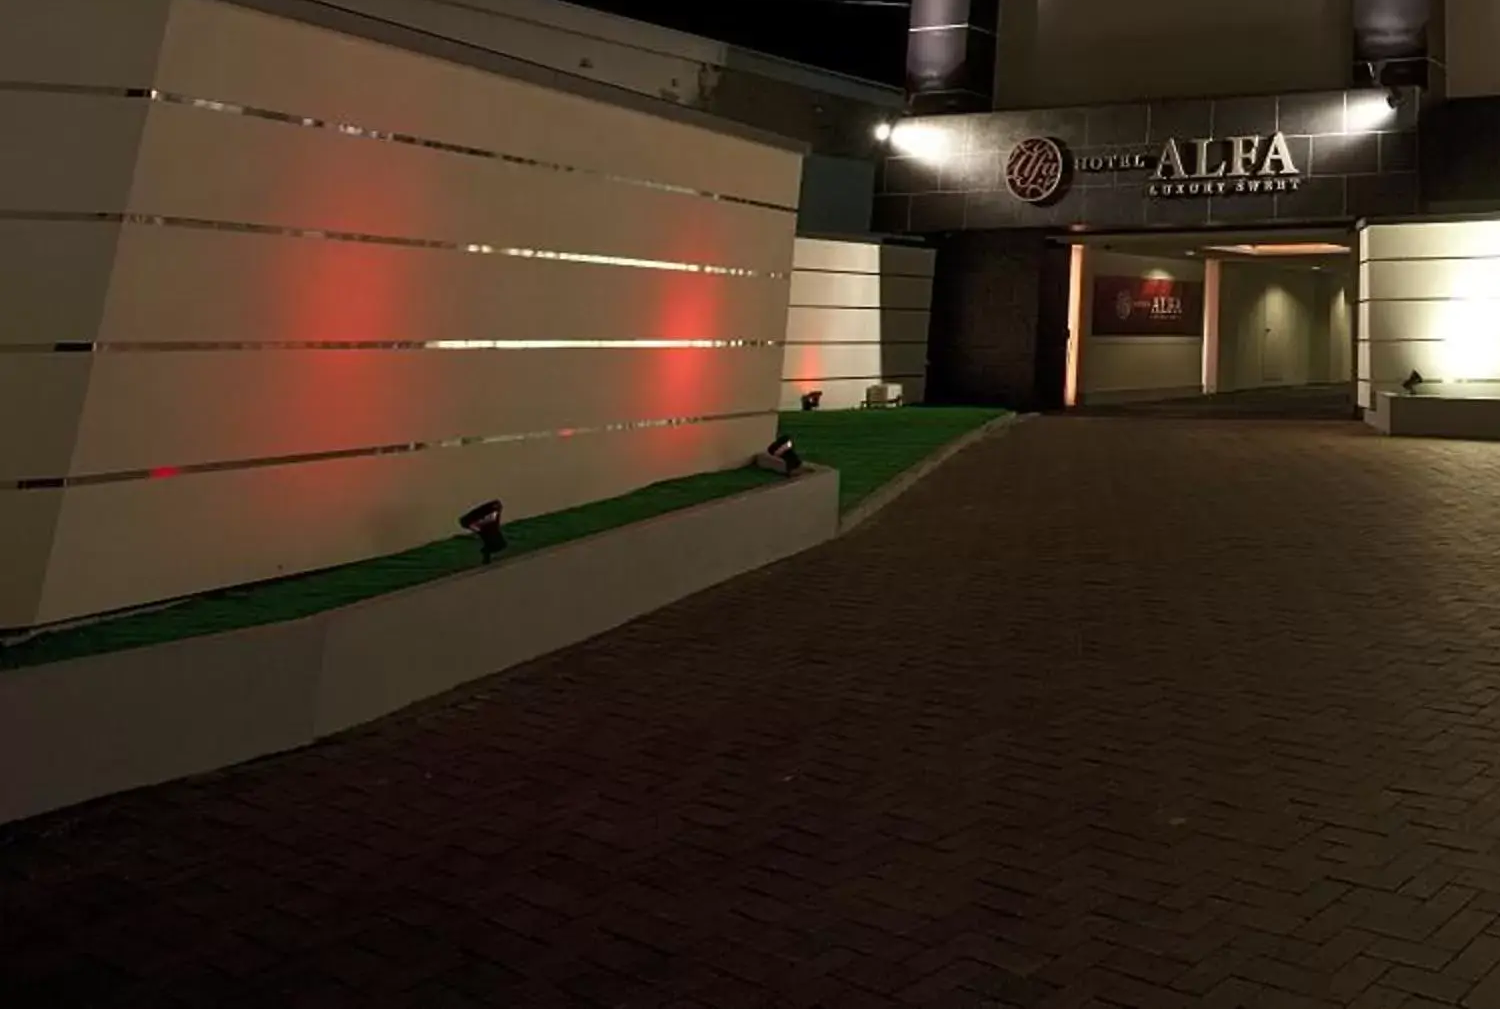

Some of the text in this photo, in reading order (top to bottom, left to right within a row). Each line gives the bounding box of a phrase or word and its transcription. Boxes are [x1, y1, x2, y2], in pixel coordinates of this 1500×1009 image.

[1073, 131, 1301, 181] HOTEL ALFA
[1149, 177, 1301, 197] LUXURY SWEET
